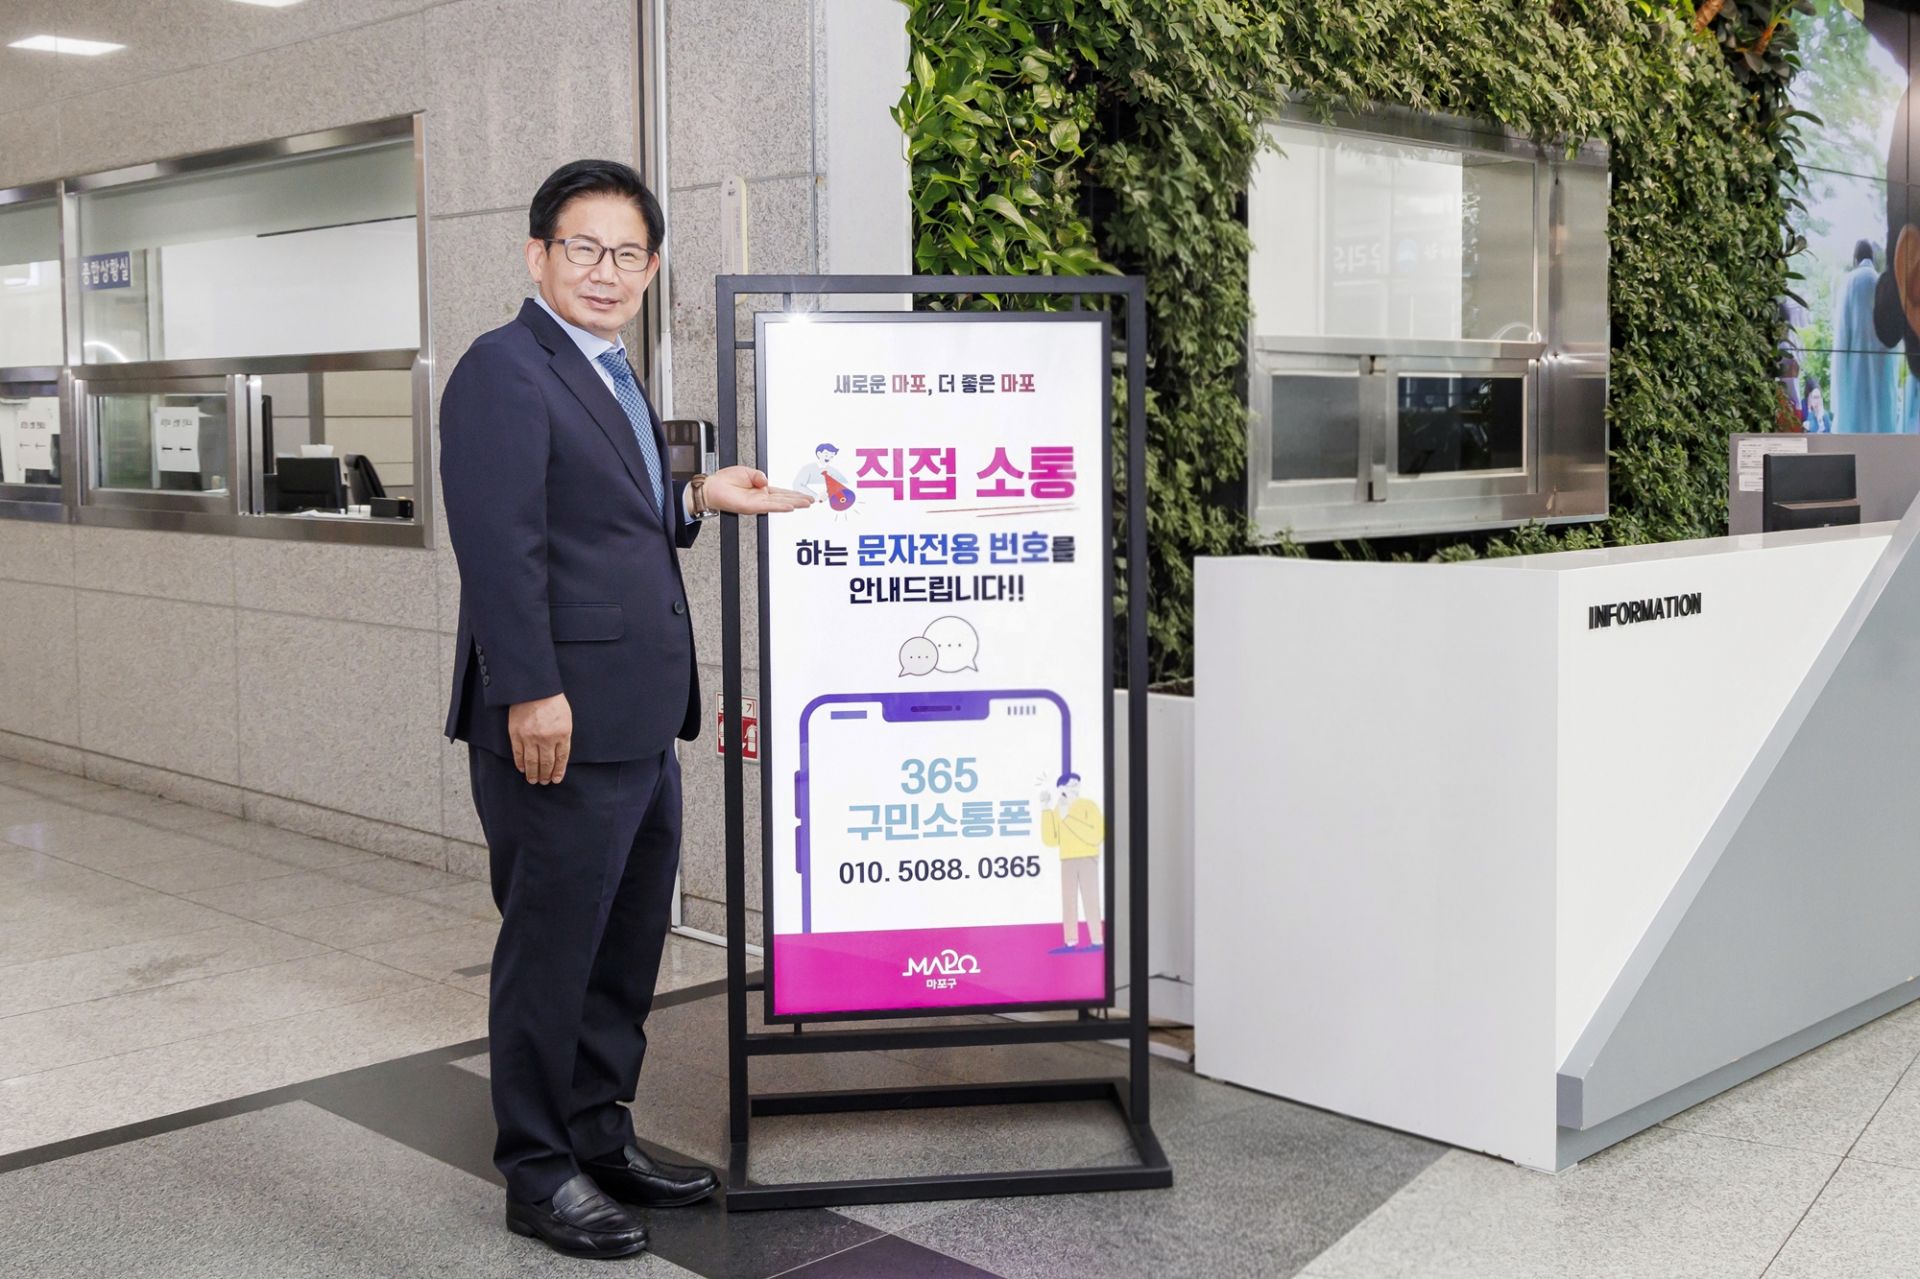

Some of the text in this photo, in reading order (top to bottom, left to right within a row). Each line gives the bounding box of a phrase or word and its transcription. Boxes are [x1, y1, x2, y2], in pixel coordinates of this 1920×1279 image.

[81, 256, 129, 285] 종합상황실
[834, 373, 1036, 397] 새로운 마포, 더 좋은 마포
[855, 446, 1077, 501] 직접 소통
[796, 530, 1076, 567] 하는 문자전용 번호를
[849, 574, 1025, 605] 안내드립니다!!
[1588, 592, 1702, 630] INFORMATION
[901, 757, 978, 795] 365
[847, 800, 1033, 841] 구민소통폰
[839, 855, 1041, 885] 010. 5088. 0365
[902, 948, 982, 977] MAPO
[926, 978, 957, 990] 마포구
